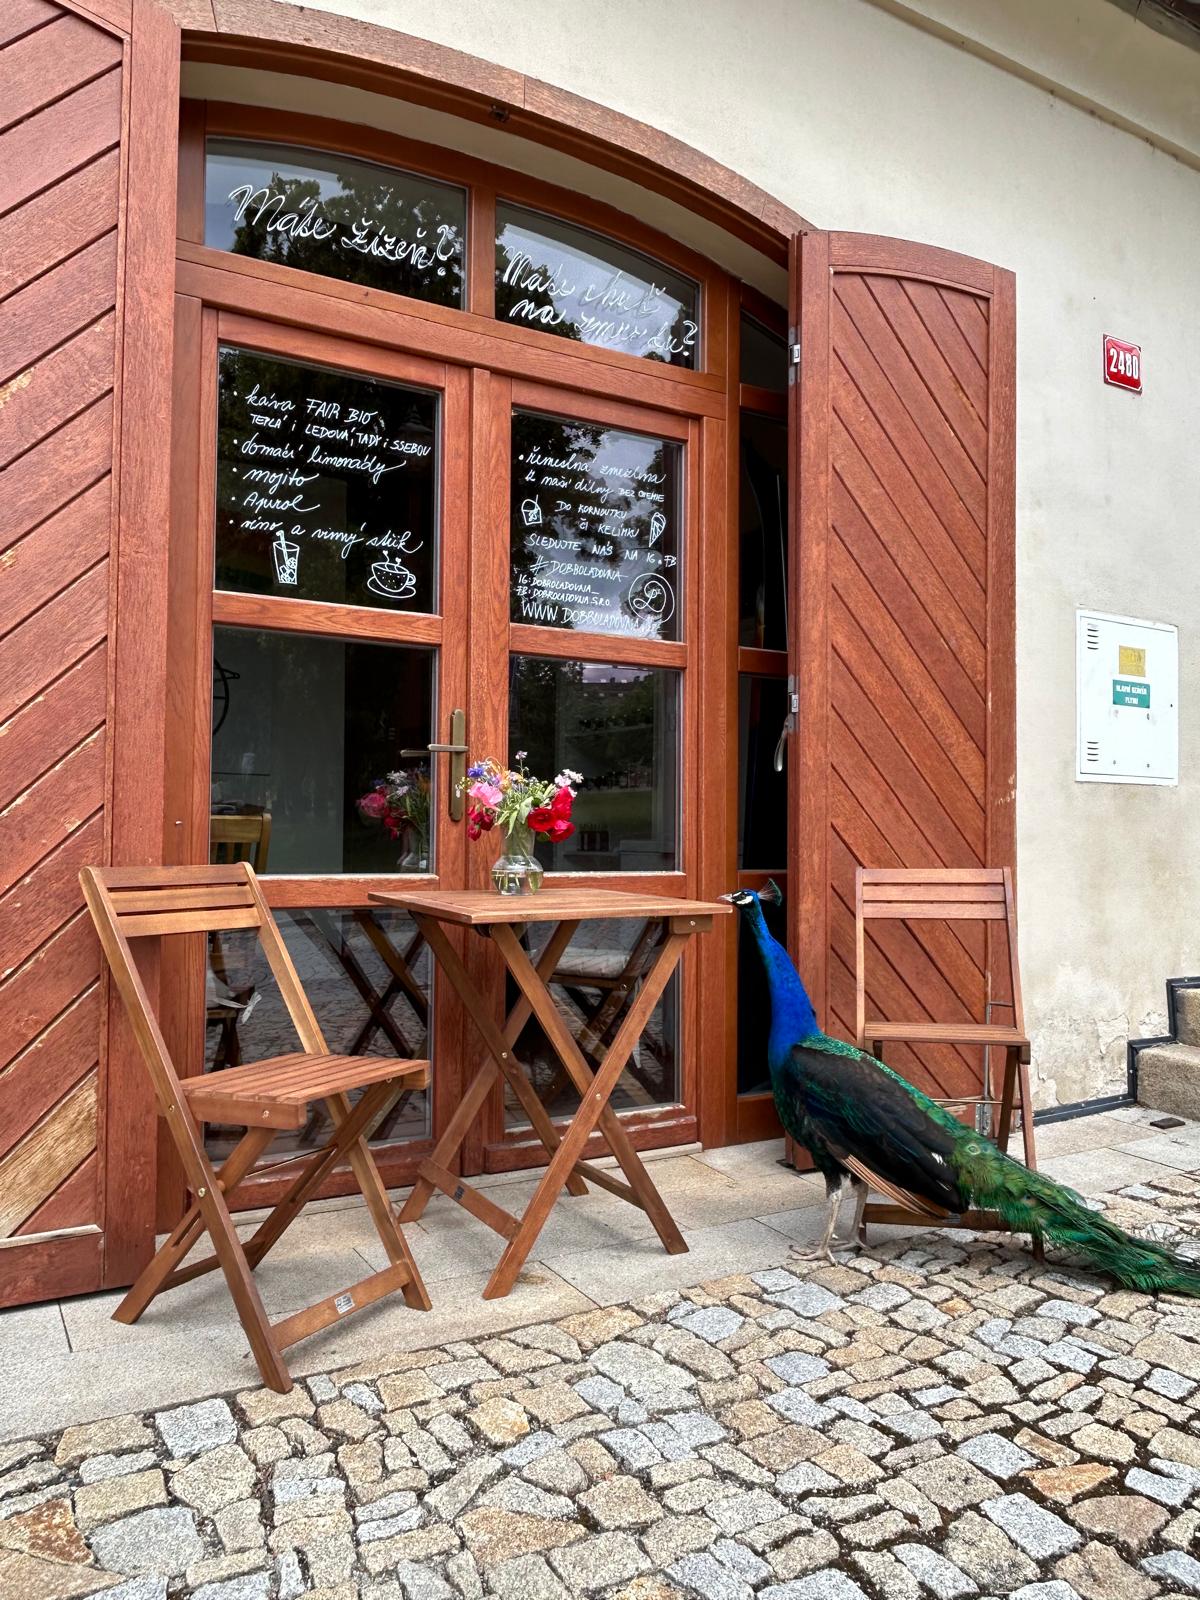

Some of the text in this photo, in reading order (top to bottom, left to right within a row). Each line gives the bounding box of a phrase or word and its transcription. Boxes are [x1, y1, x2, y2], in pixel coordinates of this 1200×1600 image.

[509, 299, 567, 325] na
[1109, 347, 1139, 380] 2480
[245, 384, 379, 425] káva FAIR BIO
[291, 420, 297, 432] i
[383, 438, 389, 448] i
[390, 440, 432, 456] SSEBOU
[307, 445, 407, 484] limonády
[243, 468, 320, 495] mojito
[555, 501, 572, 512] DO
[291, 525, 306, 535] a
[524, 533, 582, 550] SLEDUJTE
[624, 550, 638, 561] NA
